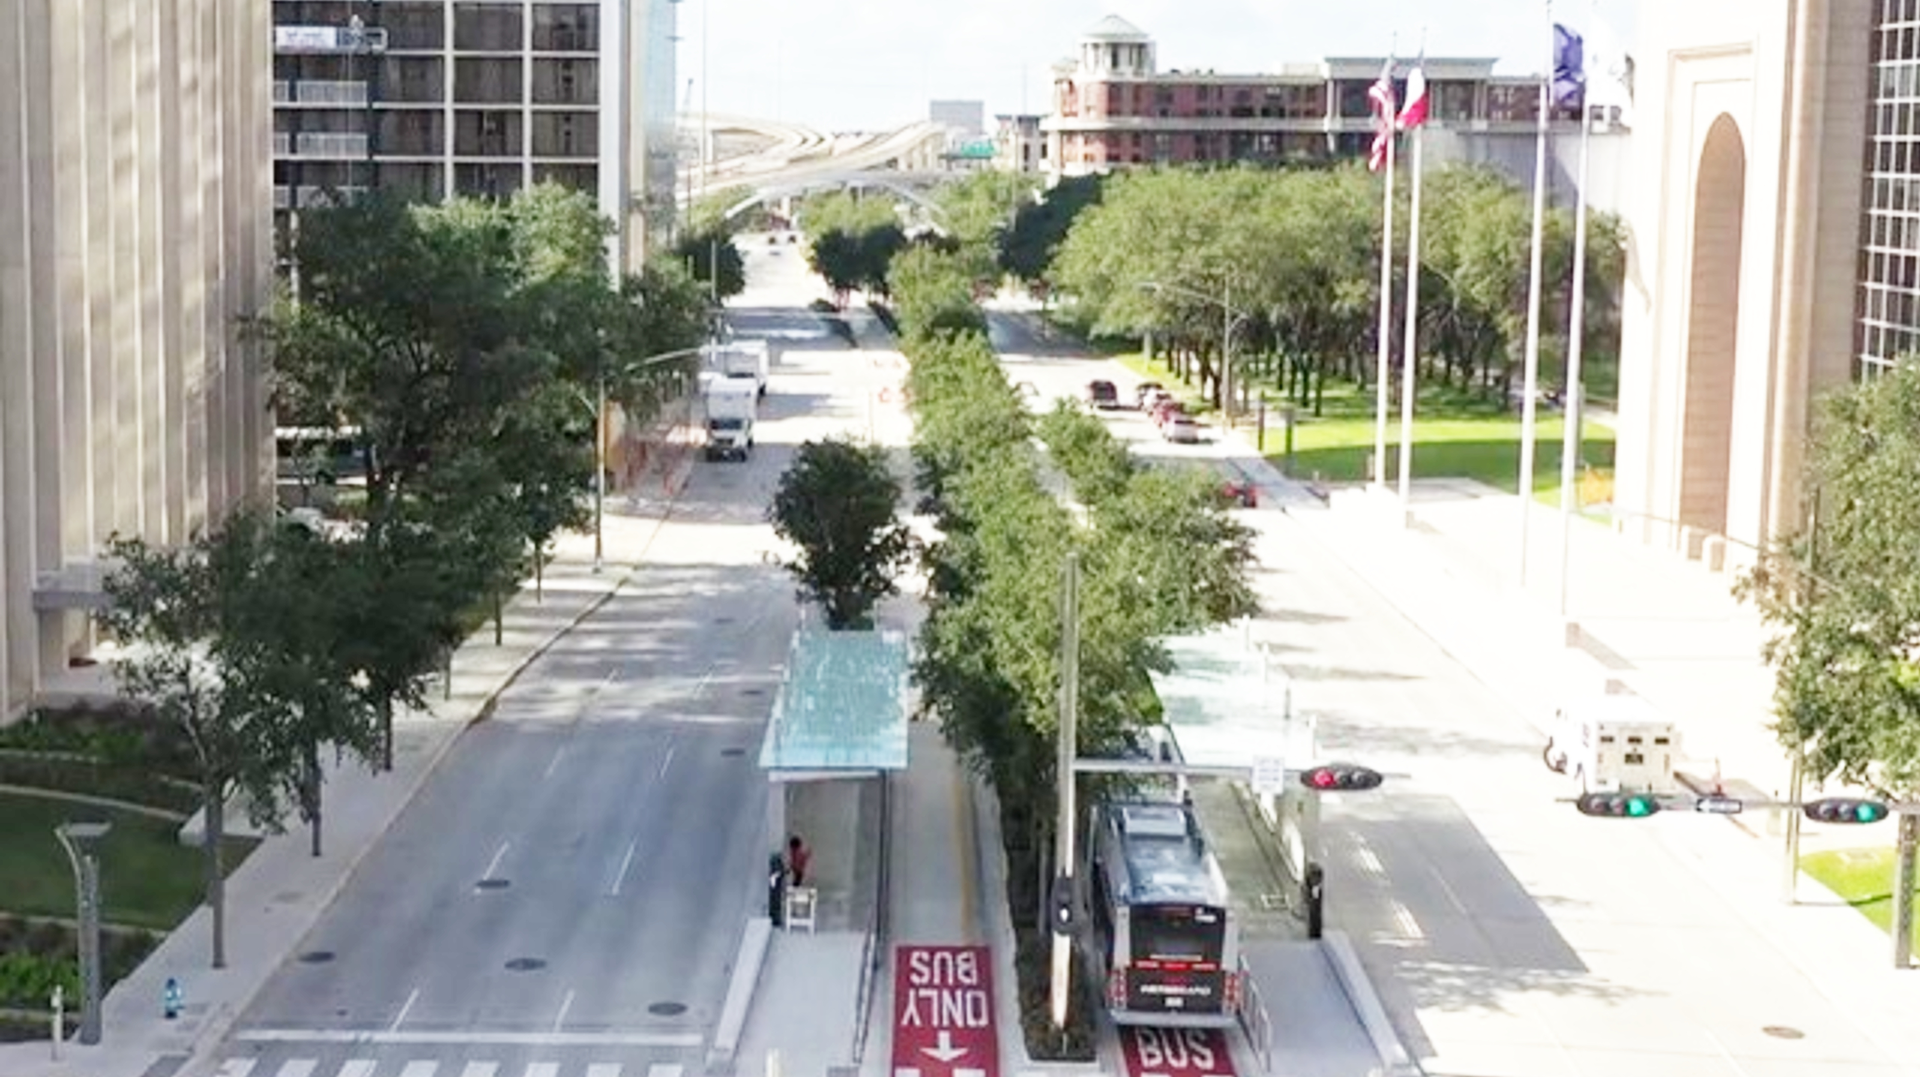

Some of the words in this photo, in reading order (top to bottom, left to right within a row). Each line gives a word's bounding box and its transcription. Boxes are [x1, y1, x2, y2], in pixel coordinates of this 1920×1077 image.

[910, 951, 977, 985] BUS
[901, 990, 989, 1028] ONLY
[1135, 1028, 1215, 1070] BUS
